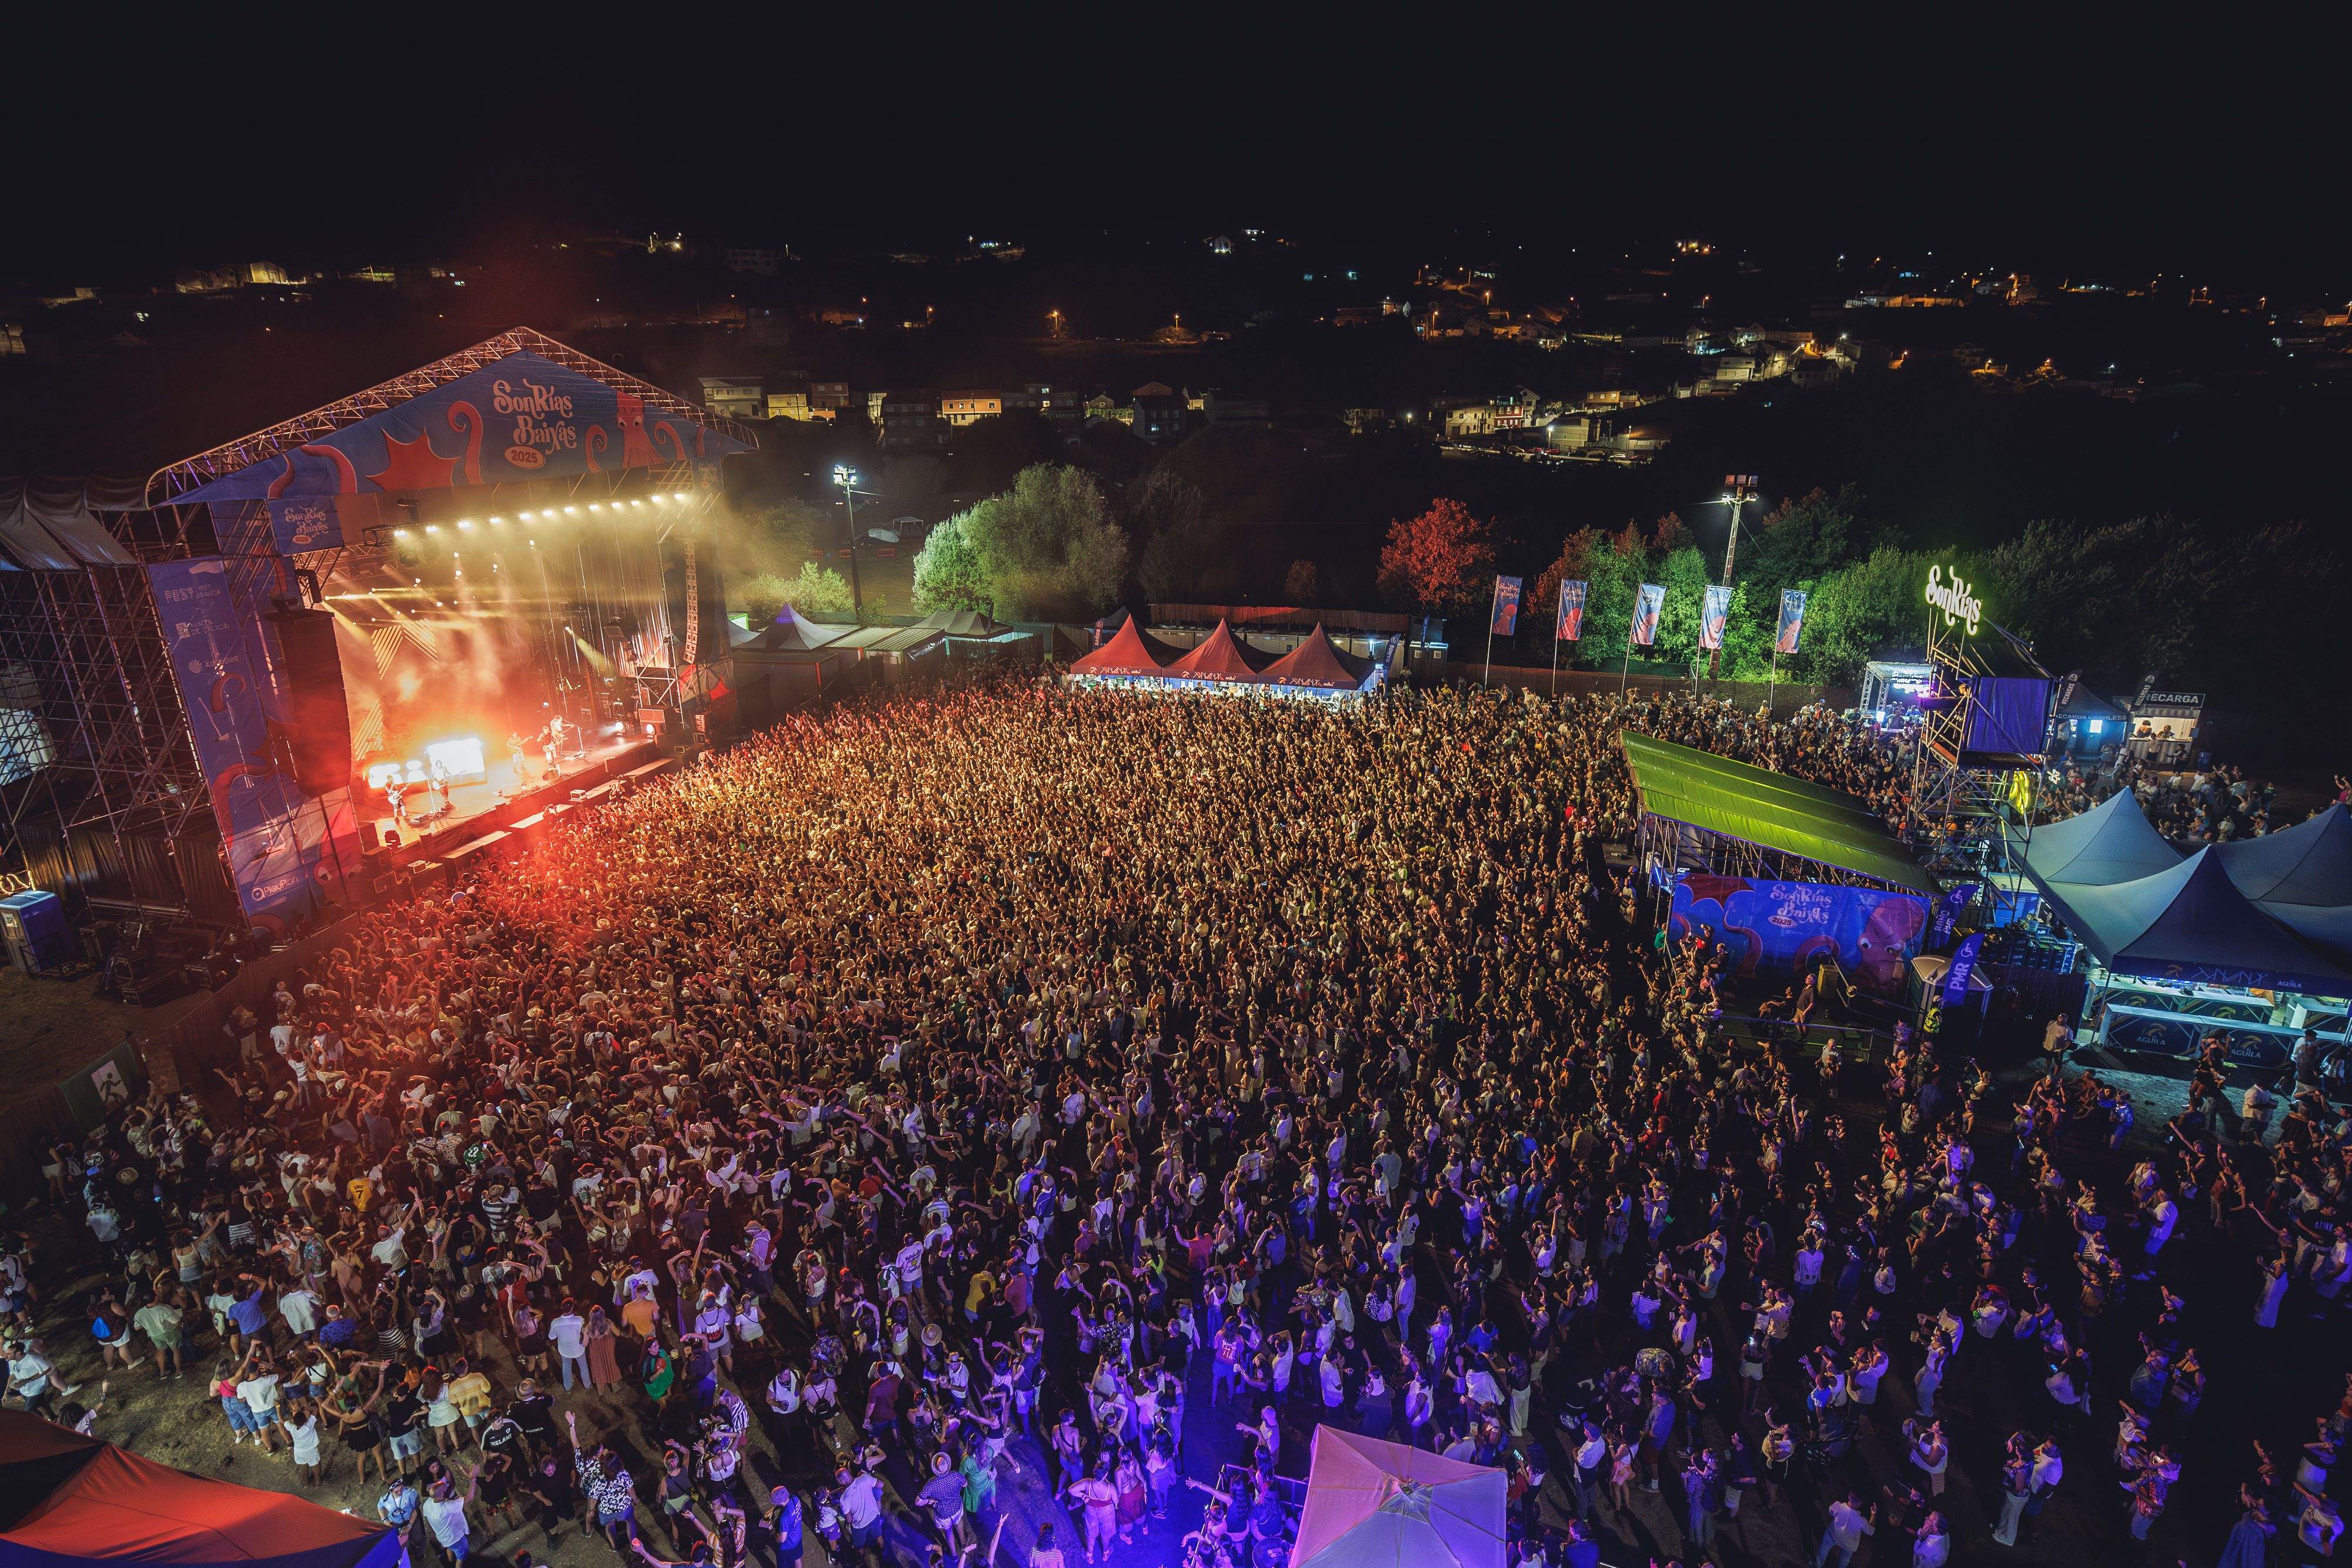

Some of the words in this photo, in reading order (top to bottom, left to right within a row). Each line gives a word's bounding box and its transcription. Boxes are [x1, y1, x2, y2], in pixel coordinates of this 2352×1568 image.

[493, 379, 573, 420] SonRías
[513, 415, 577, 455] Baixas
[510, 450, 537, 463] 2025
[1925, 564, 1982, 636] SonRías
[1771, 917, 1792, 926] 2025
[1949, 962, 1970, 992] PMR
